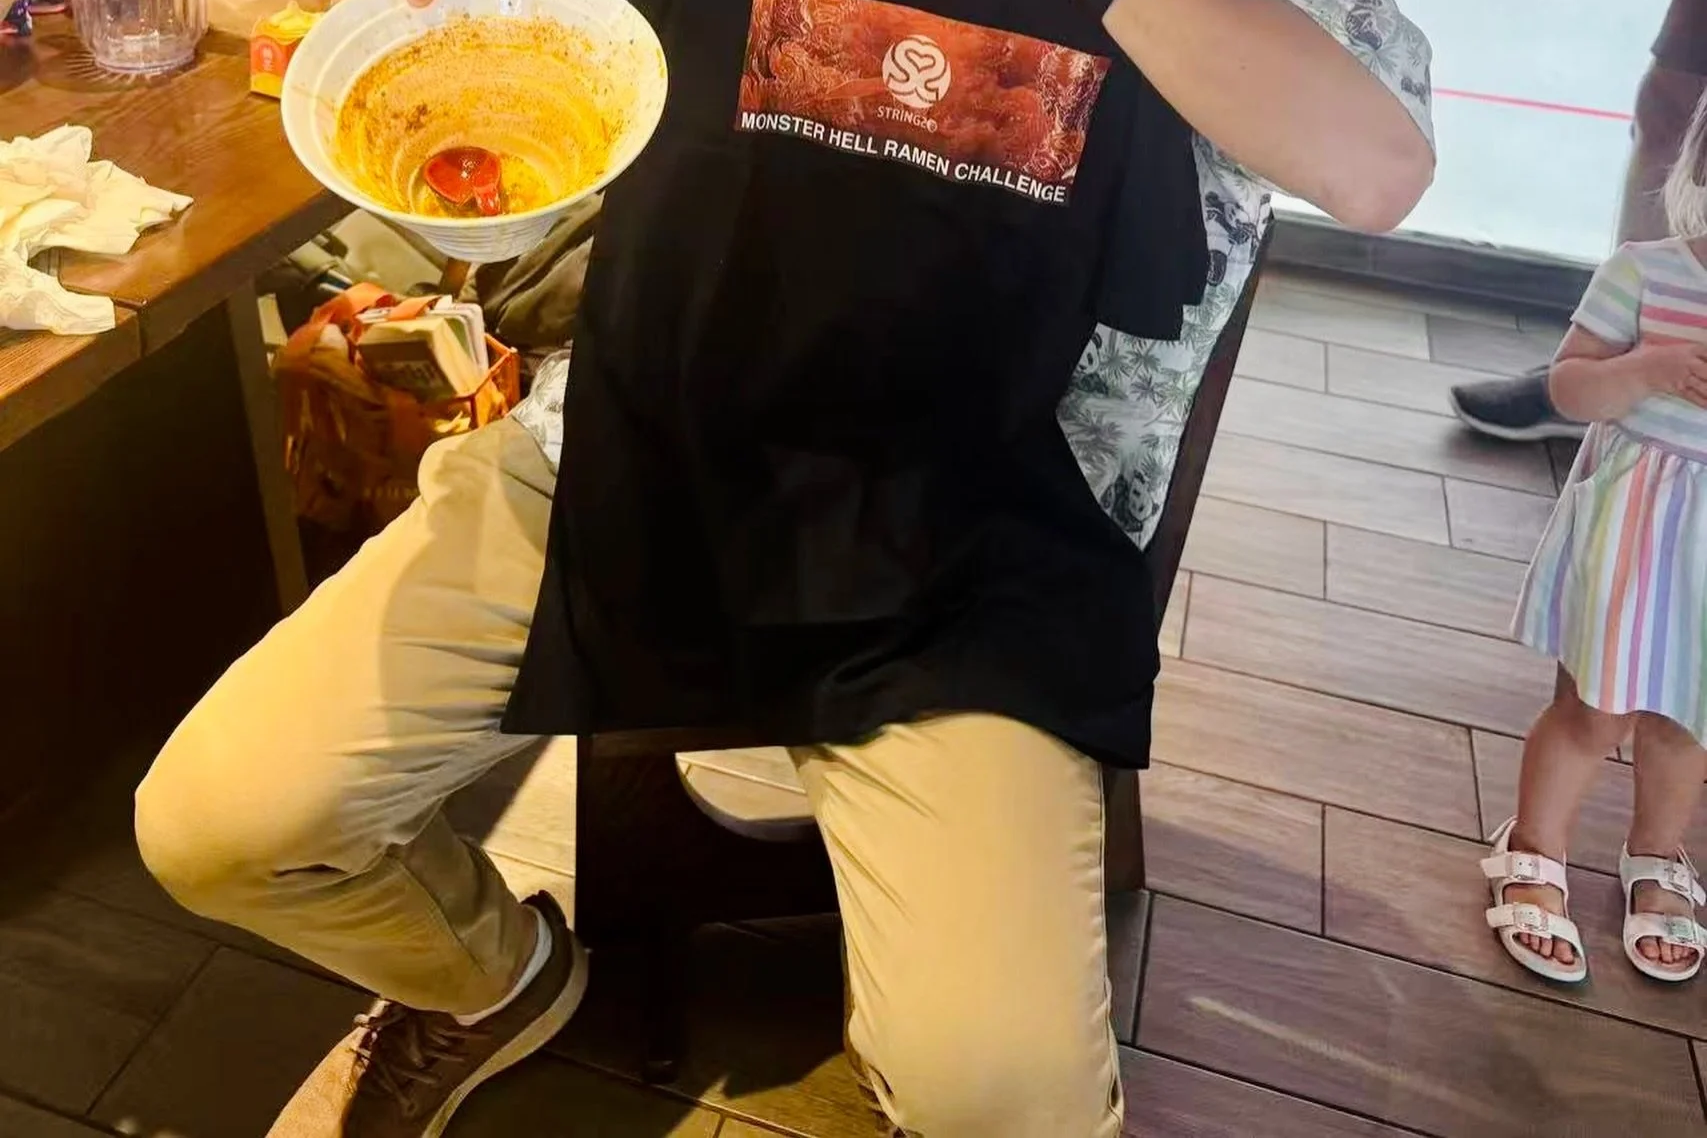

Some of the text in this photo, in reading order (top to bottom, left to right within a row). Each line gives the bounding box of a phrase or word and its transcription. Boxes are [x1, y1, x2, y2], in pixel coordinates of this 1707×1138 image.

[741, 112, 1066, 202] MONSTER HELL RAMEN CHALLENGE
